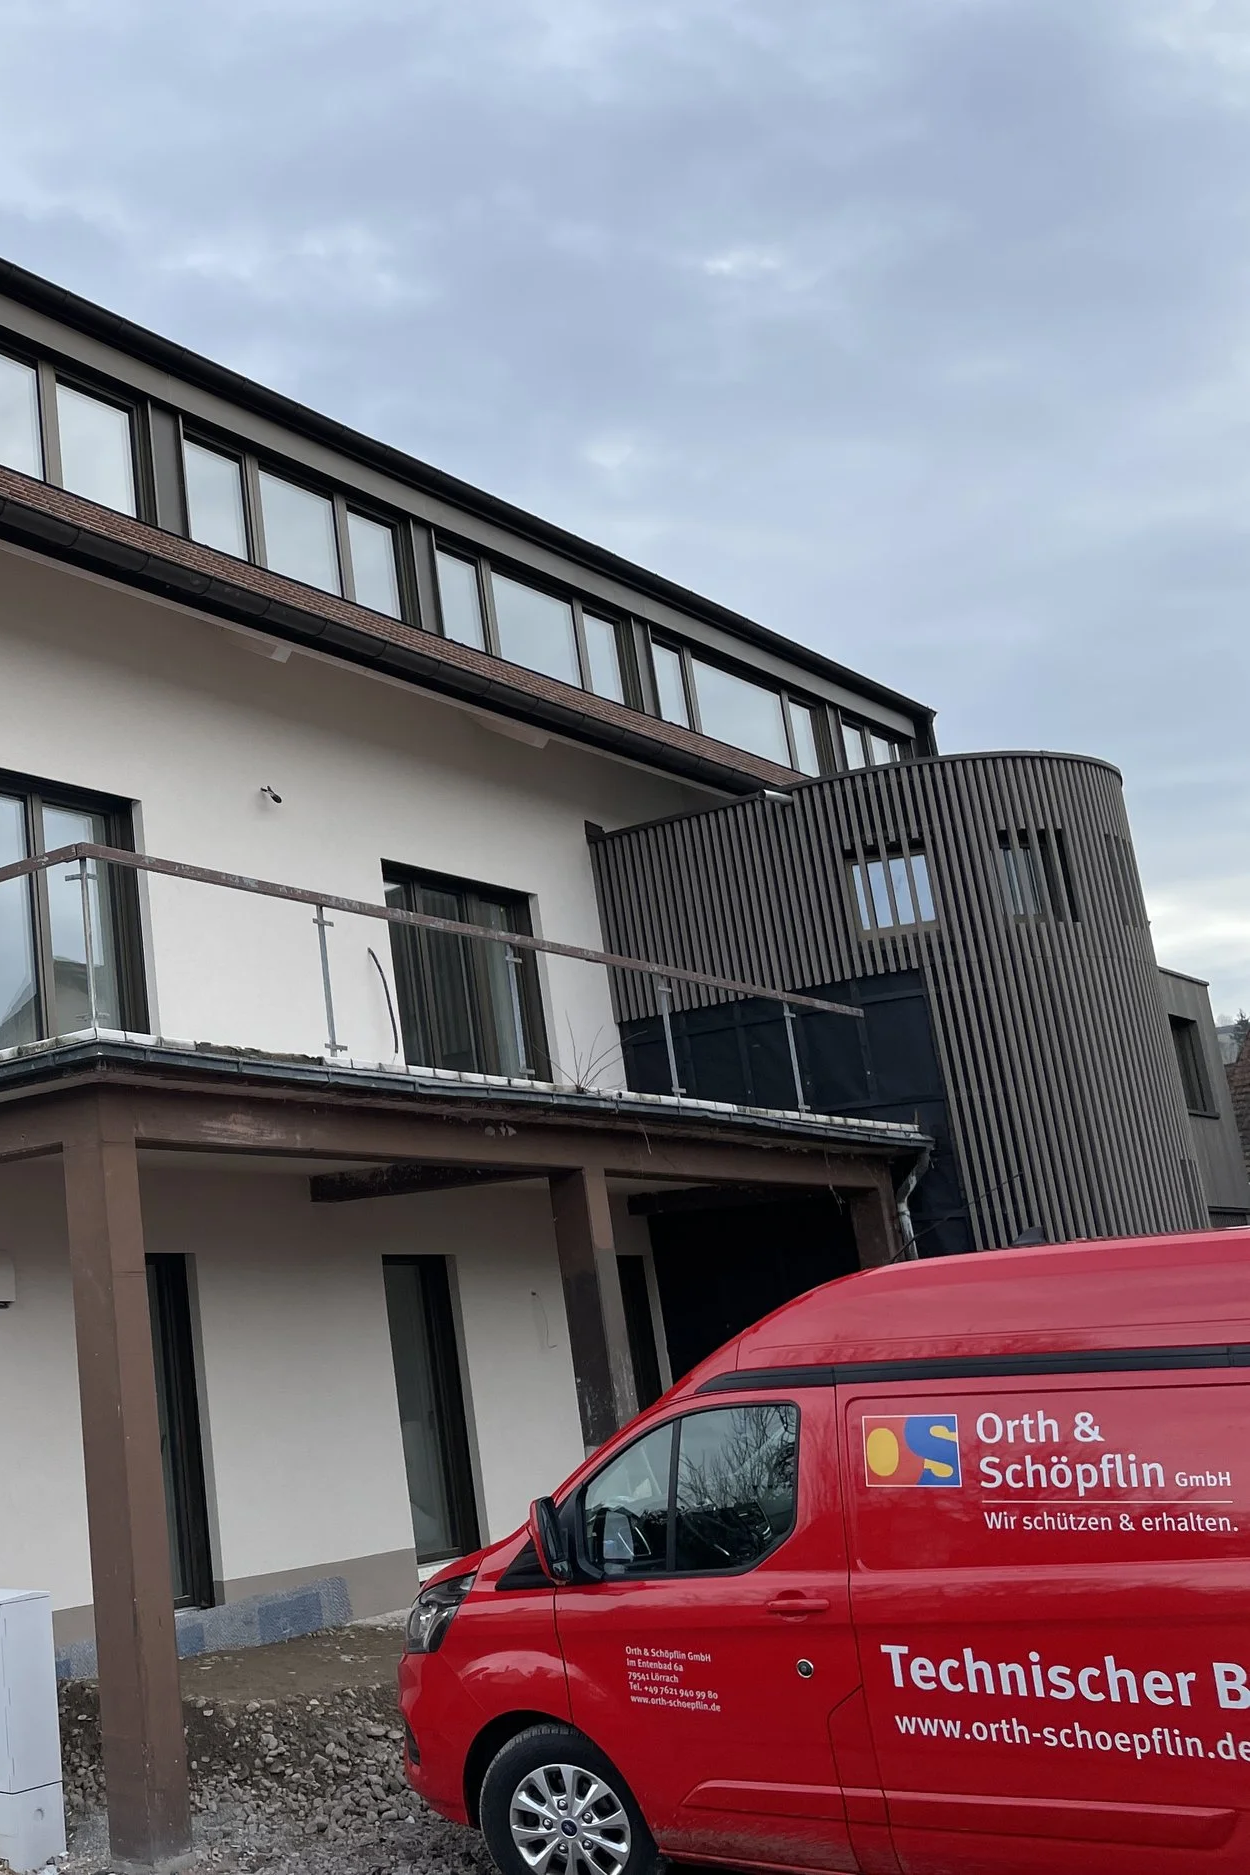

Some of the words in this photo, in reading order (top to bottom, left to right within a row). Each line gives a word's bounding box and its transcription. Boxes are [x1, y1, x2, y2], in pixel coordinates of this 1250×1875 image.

[975, 1410, 1060, 1444] Orth
[1073, 1411, 1105, 1442] &
[979, 1453, 1166, 1497] Schöpflin
[1174, 1471, 1232, 1488] GmbH
[983, 1511, 1018, 1531] Wir
[1022, 1512, 1113, 1532] schützen
[1119, 1514, 1136, 1532] &
[1141, 1511, 1240, 1533] erhalten.
[625, 1645, 642, 1655] Orth
[643, 1647, 650, 1656] &
[651, 1648, 687, 1660] Schöpflin
[687, 1651, 712, 1662] GmbH
[626, 1658, 637, 1666] Im
[637, 1658, 673, 1670] Entenbad
[673, 1662, 684, 1672] 6a
[627, 1671, 650, 1681] 79541
[650, 1671, 679, 1683] Lörrach
[880, 1644, 1197, 1708] Technischer
[1212, 1661, 1250, 1710] B
[629, 1681, 643, 1691] Tel.
[644, 1684, 659, 1694] +49
[659, 1685, 678, 1695] 7621
[679, 1688, 695, 1697] 940
[695, 1690, 706, 1699] 99
[707, 1690, 719, 1699] 80
[630, 1695, 722, 1712] www.orth-schoepflin.de
